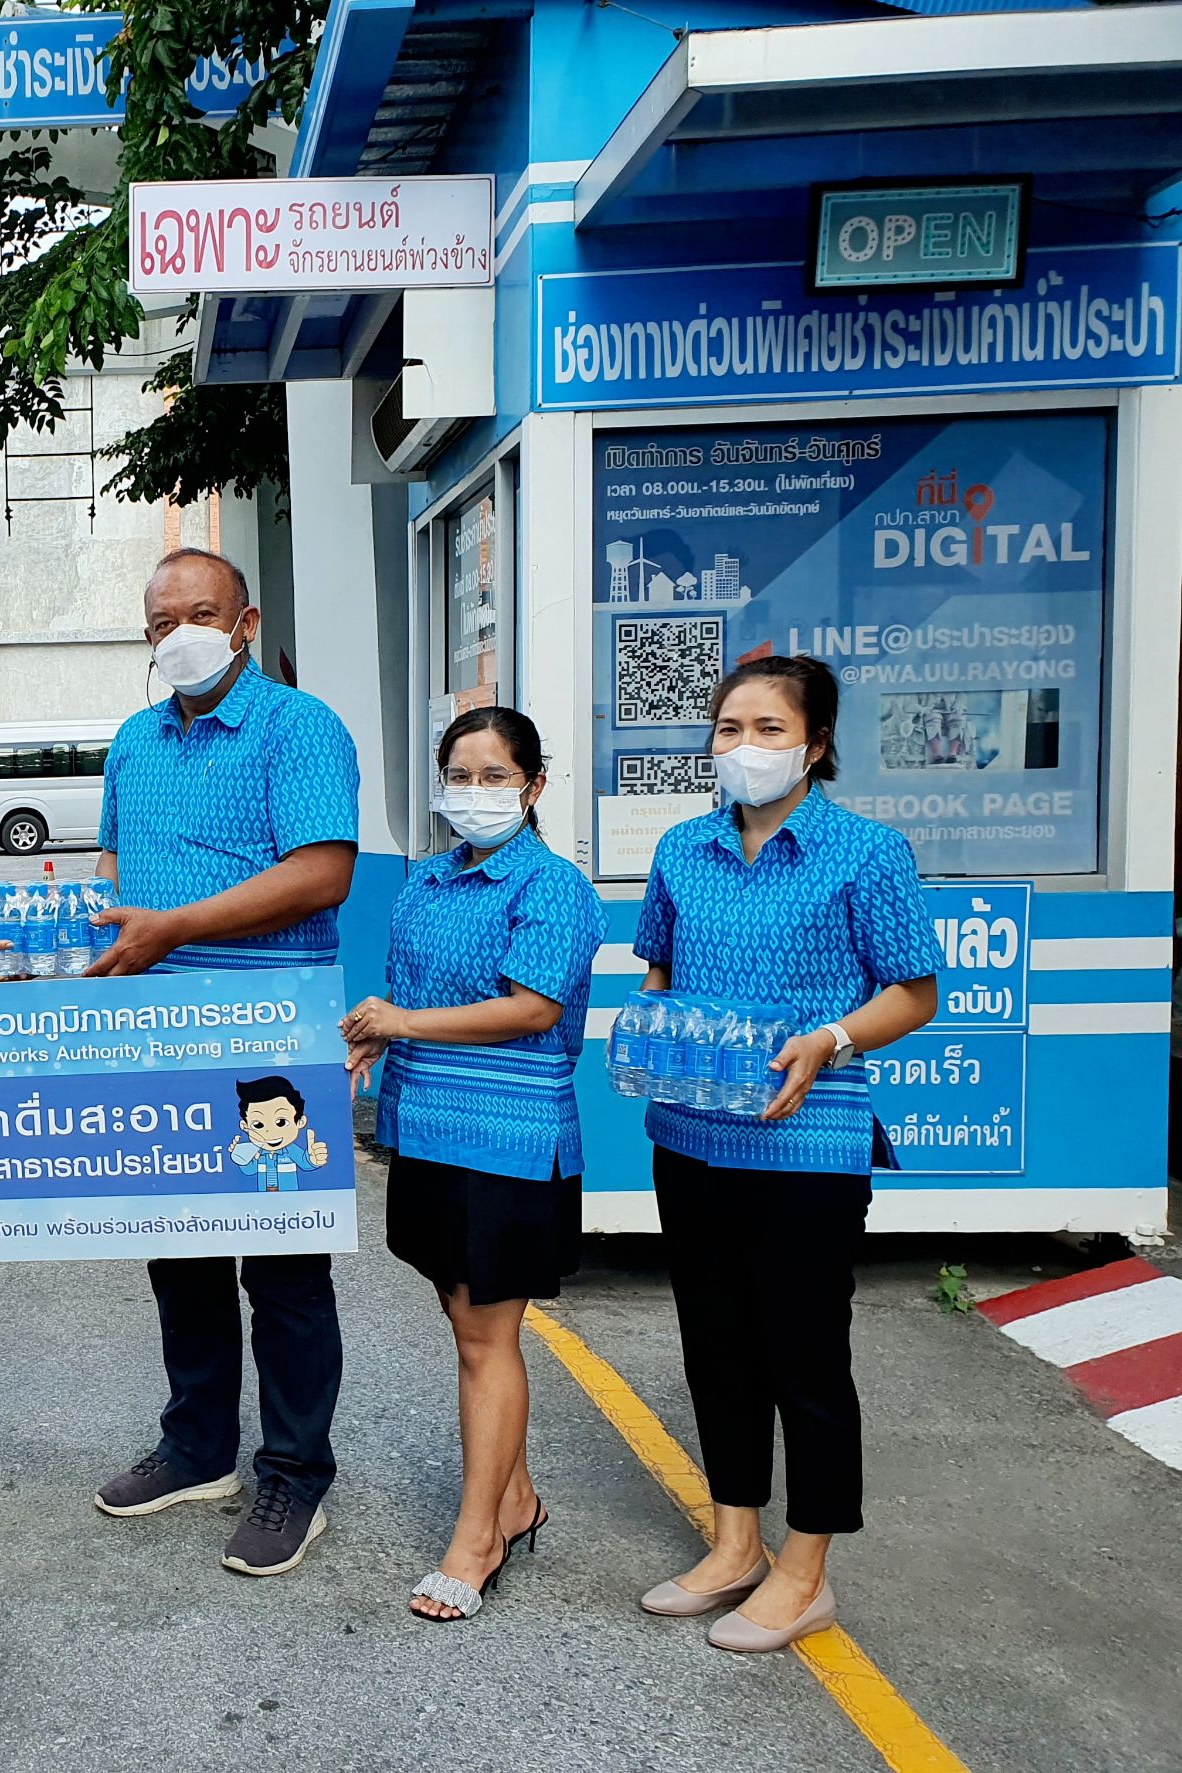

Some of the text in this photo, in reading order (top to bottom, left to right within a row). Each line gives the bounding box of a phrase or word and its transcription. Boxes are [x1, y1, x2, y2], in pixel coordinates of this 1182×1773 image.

[288, 184, 401, 231] รถยนต์
[140, 207, 281, 276] เฉพาะ
[288, 234, 488, 274] จักรยานยนต์พ่วงข้าง
[838, 211, 996, 263] OPEN
[606, 434, 882, 470] เปิดทำการ วันจันทร์-วันศุกร์
[606, 483, 636, 497] เวลา
[916, 467, 958, 506] ที่นี่
[840, 660, 1076, 685] @PWA.UU.RAYONG
[983, 791, 1074, 817] PAGE
[56, 1042, 142, 1062] Authority
[150, 1040, 222, 1059] Rayong
[230, 1035, 299, 1054] Branch
[864, 1044, 982, 1085] รวดเร็ว
[882, 1106, 1012, 1147] อดีกับค่าน้ำ
[46, 1210, 335, 1236] พร้อมร่วมสร้างสังคมน่าอยู่ต่อไป
